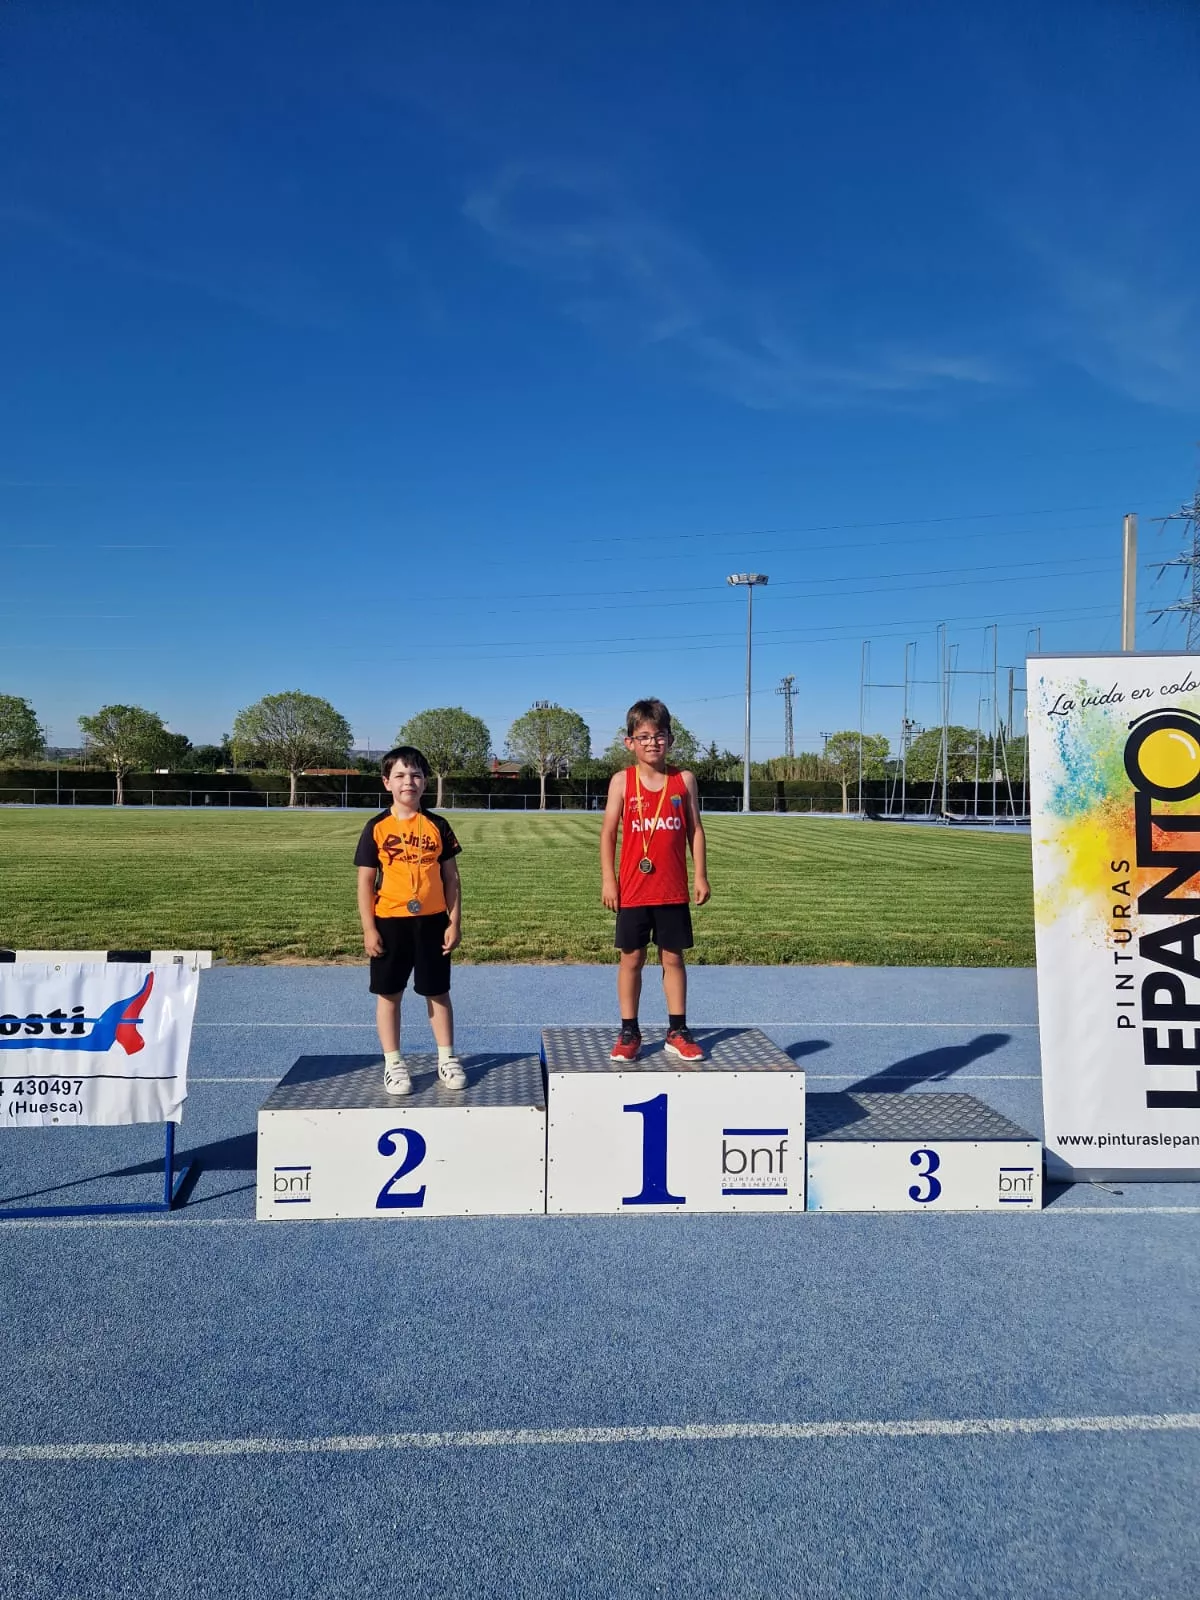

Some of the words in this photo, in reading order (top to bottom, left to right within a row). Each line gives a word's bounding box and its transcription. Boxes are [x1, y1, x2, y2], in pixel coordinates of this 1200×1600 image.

[1047, 693, 1075, 716] La
[1081, 682, 1125, 708] vida
[1131, 687, 1154, 700] en
[1160, 671, 1200, 696] colo
[1111, 860, 1136, 1029] PINTURAS
[13, 1080, 83, 1096] 430497
[9, 1100, 83, 1118] (Huesca)
[376, 1128, 427, 1209] 2
[622, 1093, 686, 1205] 1
[722, 1140, 788, 1174] bnf
[274, 1172, 311, 1191] bnf
[909, 1149, 942, 1203] 3
[999, 1173, 1034, 1191] bnf
